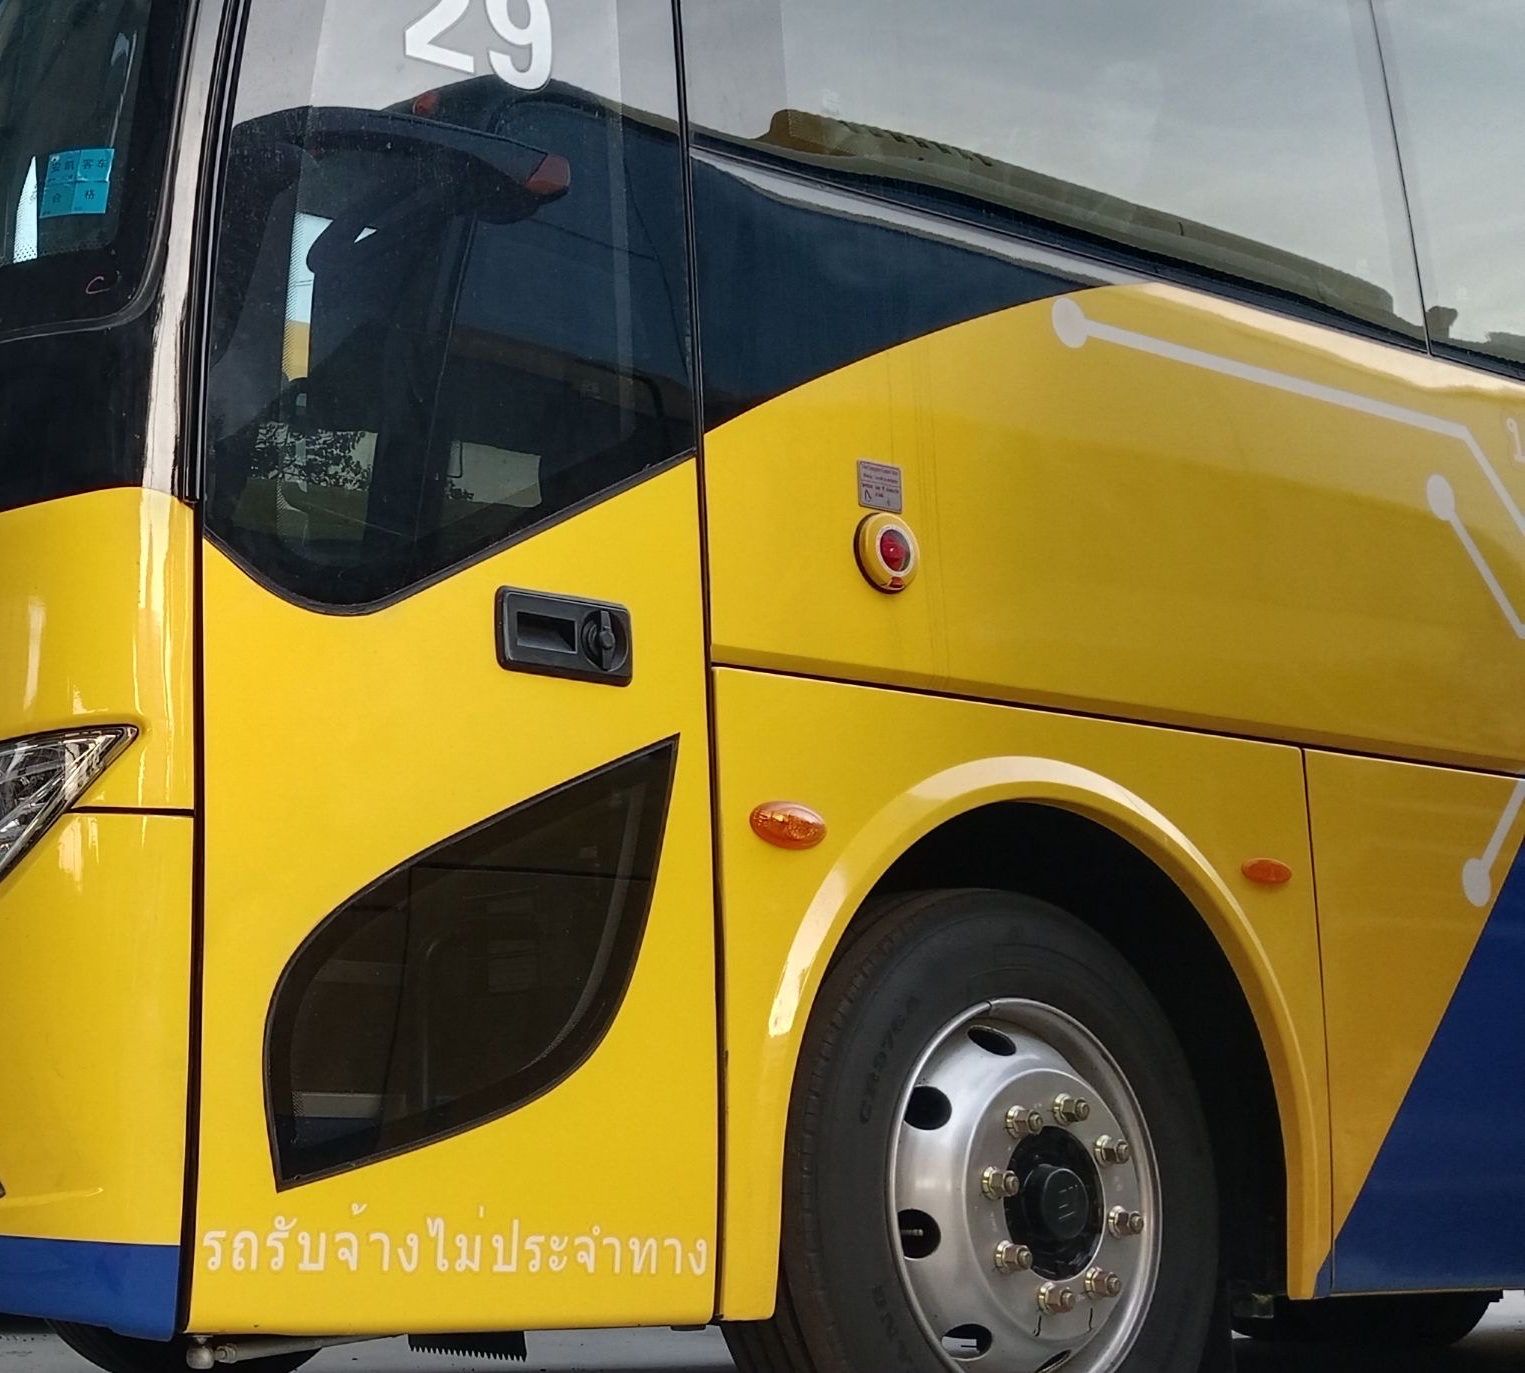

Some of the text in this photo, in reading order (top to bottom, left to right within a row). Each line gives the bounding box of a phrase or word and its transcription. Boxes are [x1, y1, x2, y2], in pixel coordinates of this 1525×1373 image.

[405, 0, 552, 90] 29
[202, 1202, 709, 1276] รถรับจ้างไม่ประจำทาง
